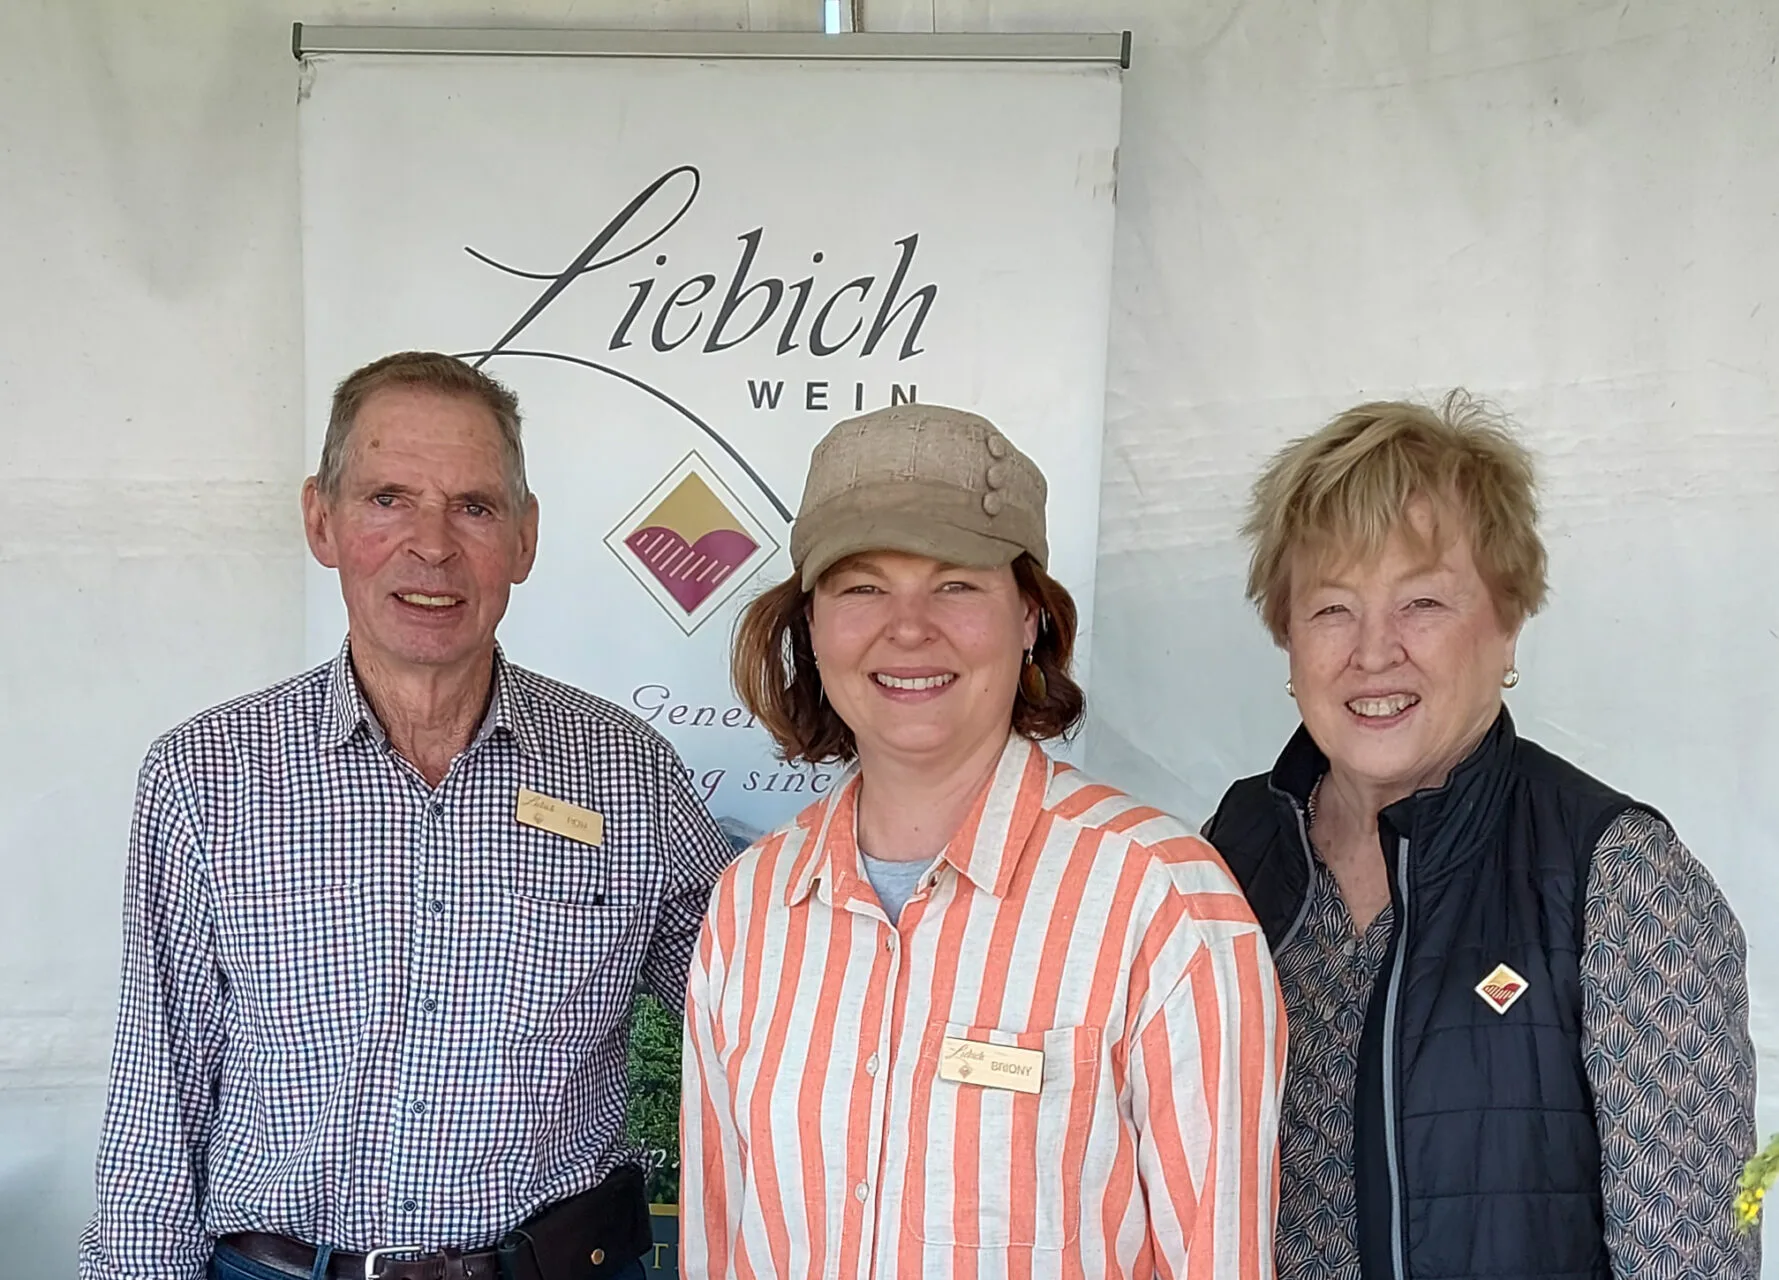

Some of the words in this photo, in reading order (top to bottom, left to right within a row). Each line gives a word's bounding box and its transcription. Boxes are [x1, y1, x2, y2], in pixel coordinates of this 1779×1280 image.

[463, 165, 940, 368] Liebich
[748, 381, 919, 408] WEIN
[743, 769, 832, 793] sinc
[991, 1061, 1033, 1077] BRIONY
